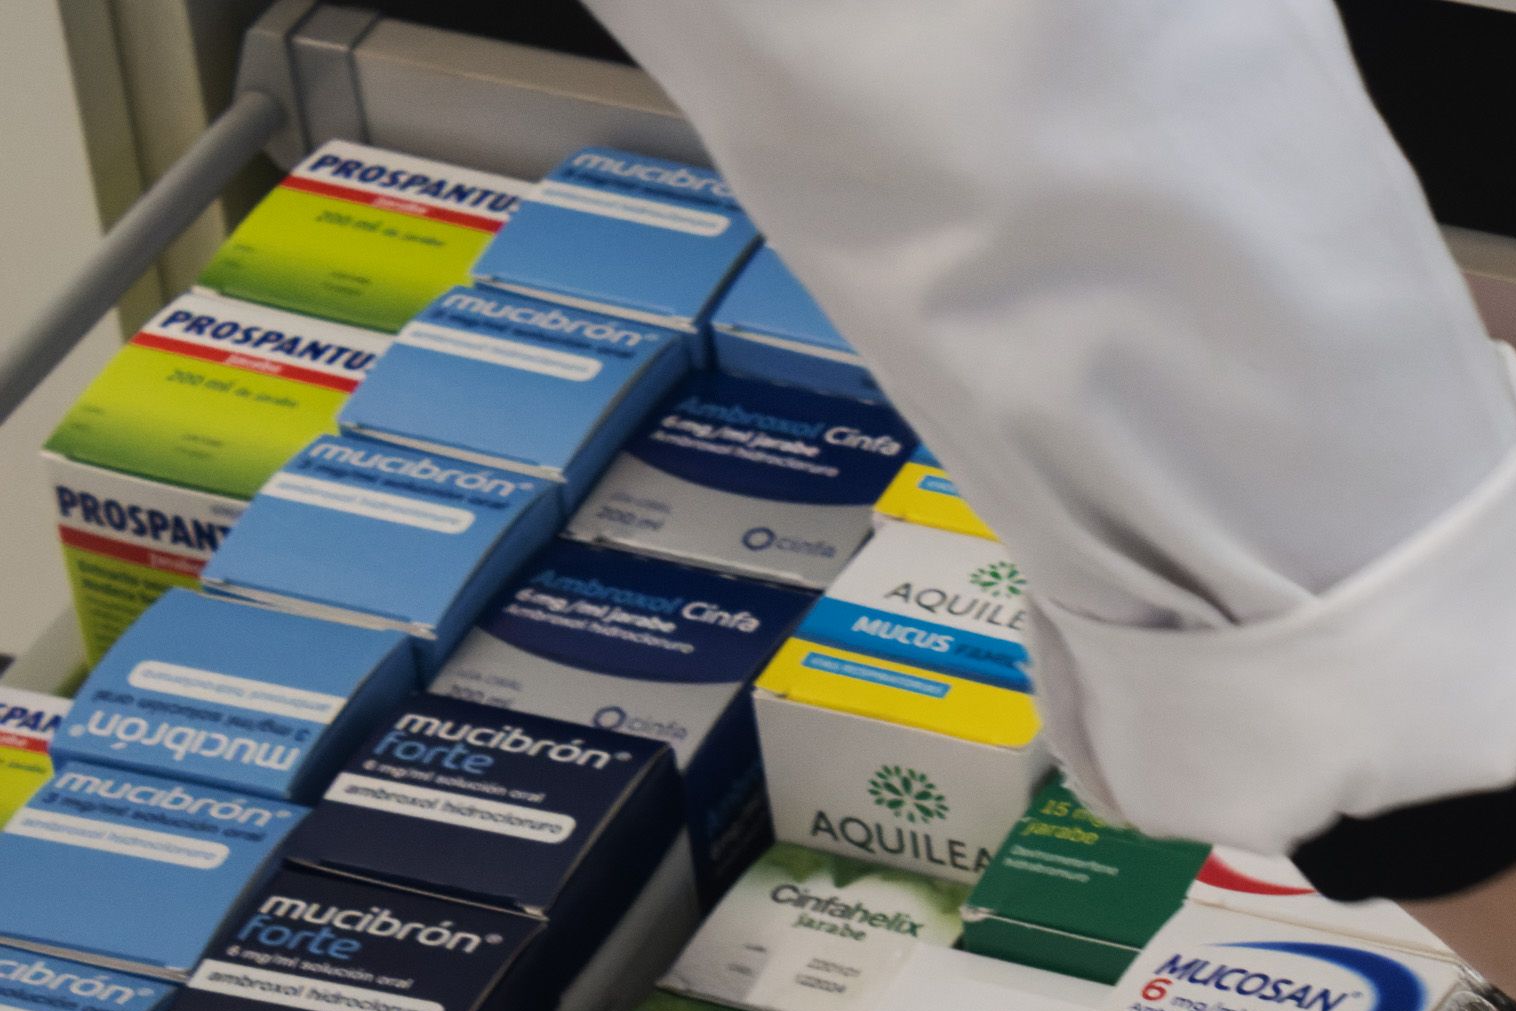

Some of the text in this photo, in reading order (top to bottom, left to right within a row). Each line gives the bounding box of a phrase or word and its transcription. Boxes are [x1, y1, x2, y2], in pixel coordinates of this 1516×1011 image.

[309, 154, 519, 212] PROSPANTU
[573, 153, 733, 197] mucibró
[160, 308, 376, 372] PROSPANTU
[441, 293, 644, 348] mucibrón
[824, 426, 901, 456] Cinfa
[308, 442, 516, 497] mucibrón
[56, 485, 233, 553] PROSPAN
[682, 601, 761, 633] Cinfa
[884, 582, 1027, 631] AQUILE
[852, 615, 954, 653] MUCUS
[88, 710, 300, 771] mucibrón
[374, 730, 495, 774] forte
[396, 713, 613, 770] mucibrón
[54, 772, 273, 827] mucibrón
[811, 808, 991, 875] AQUILEA
[237, 915, 362, 961] forte
[258, 895, 483, 954] mucibrón
[770, 884, 924, 938] Cinfahelix
[0, 959, 136, 1006] cibrón
[207, 968, 305, 999] ambroxol
[1141, 977, 1172, 1002] 6
